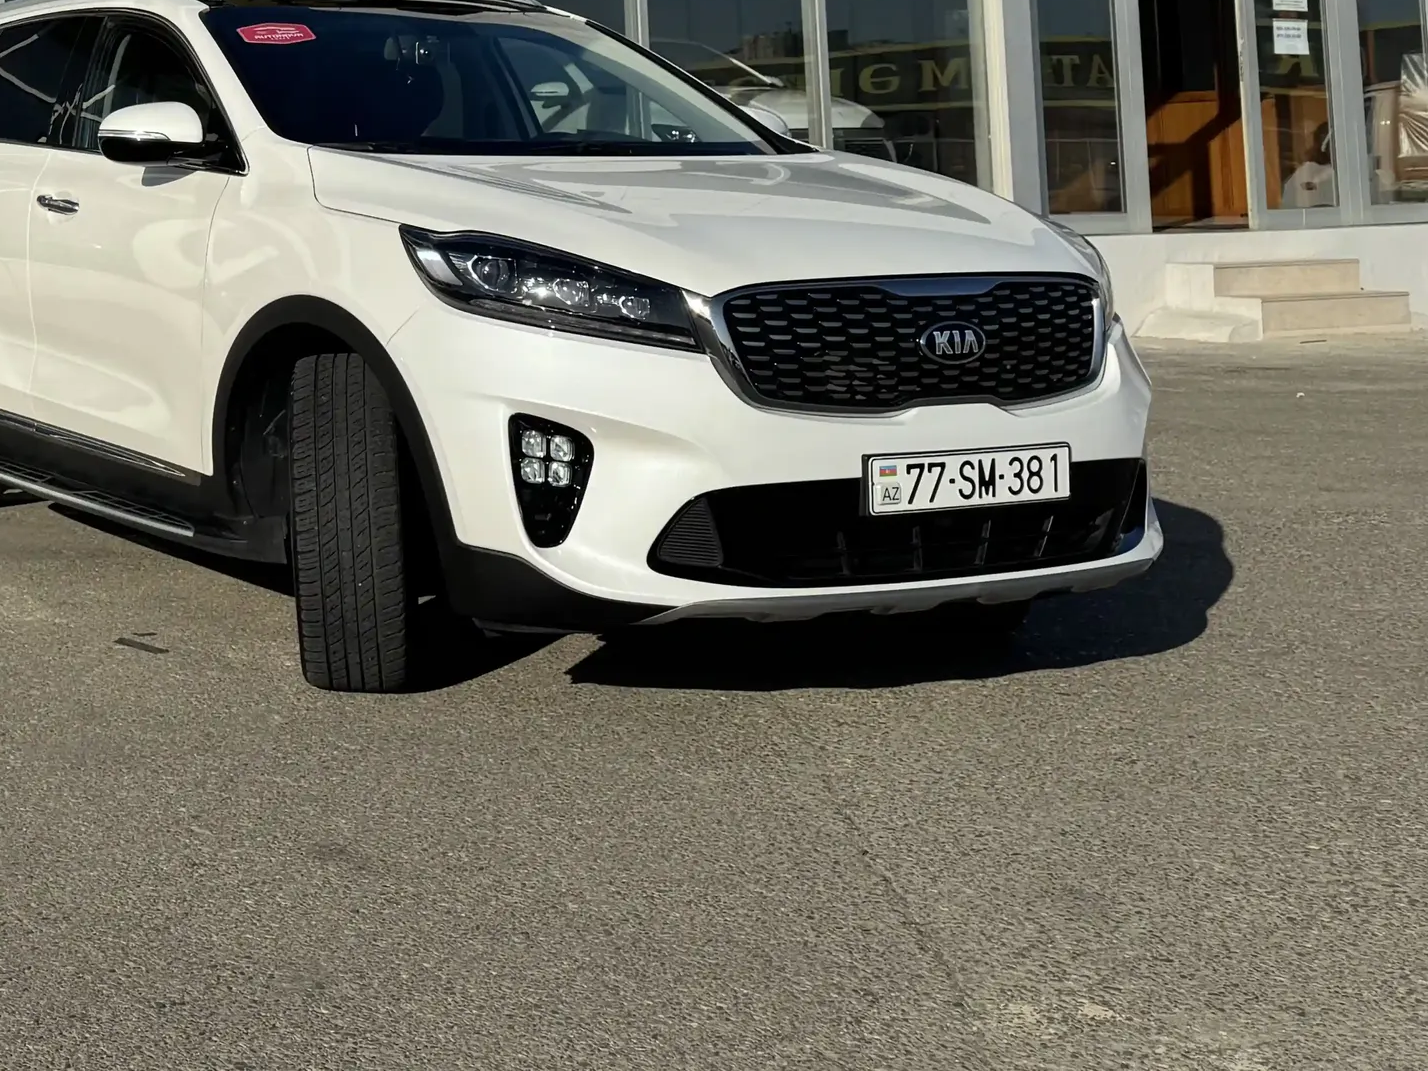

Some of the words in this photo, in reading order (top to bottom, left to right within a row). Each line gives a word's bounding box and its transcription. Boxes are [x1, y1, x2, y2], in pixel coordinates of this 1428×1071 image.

[932, 329, 979, 356] KIA
[881, 485, 901, 502] AZ
[905, 452, 1059, 505] 77-SM-381
